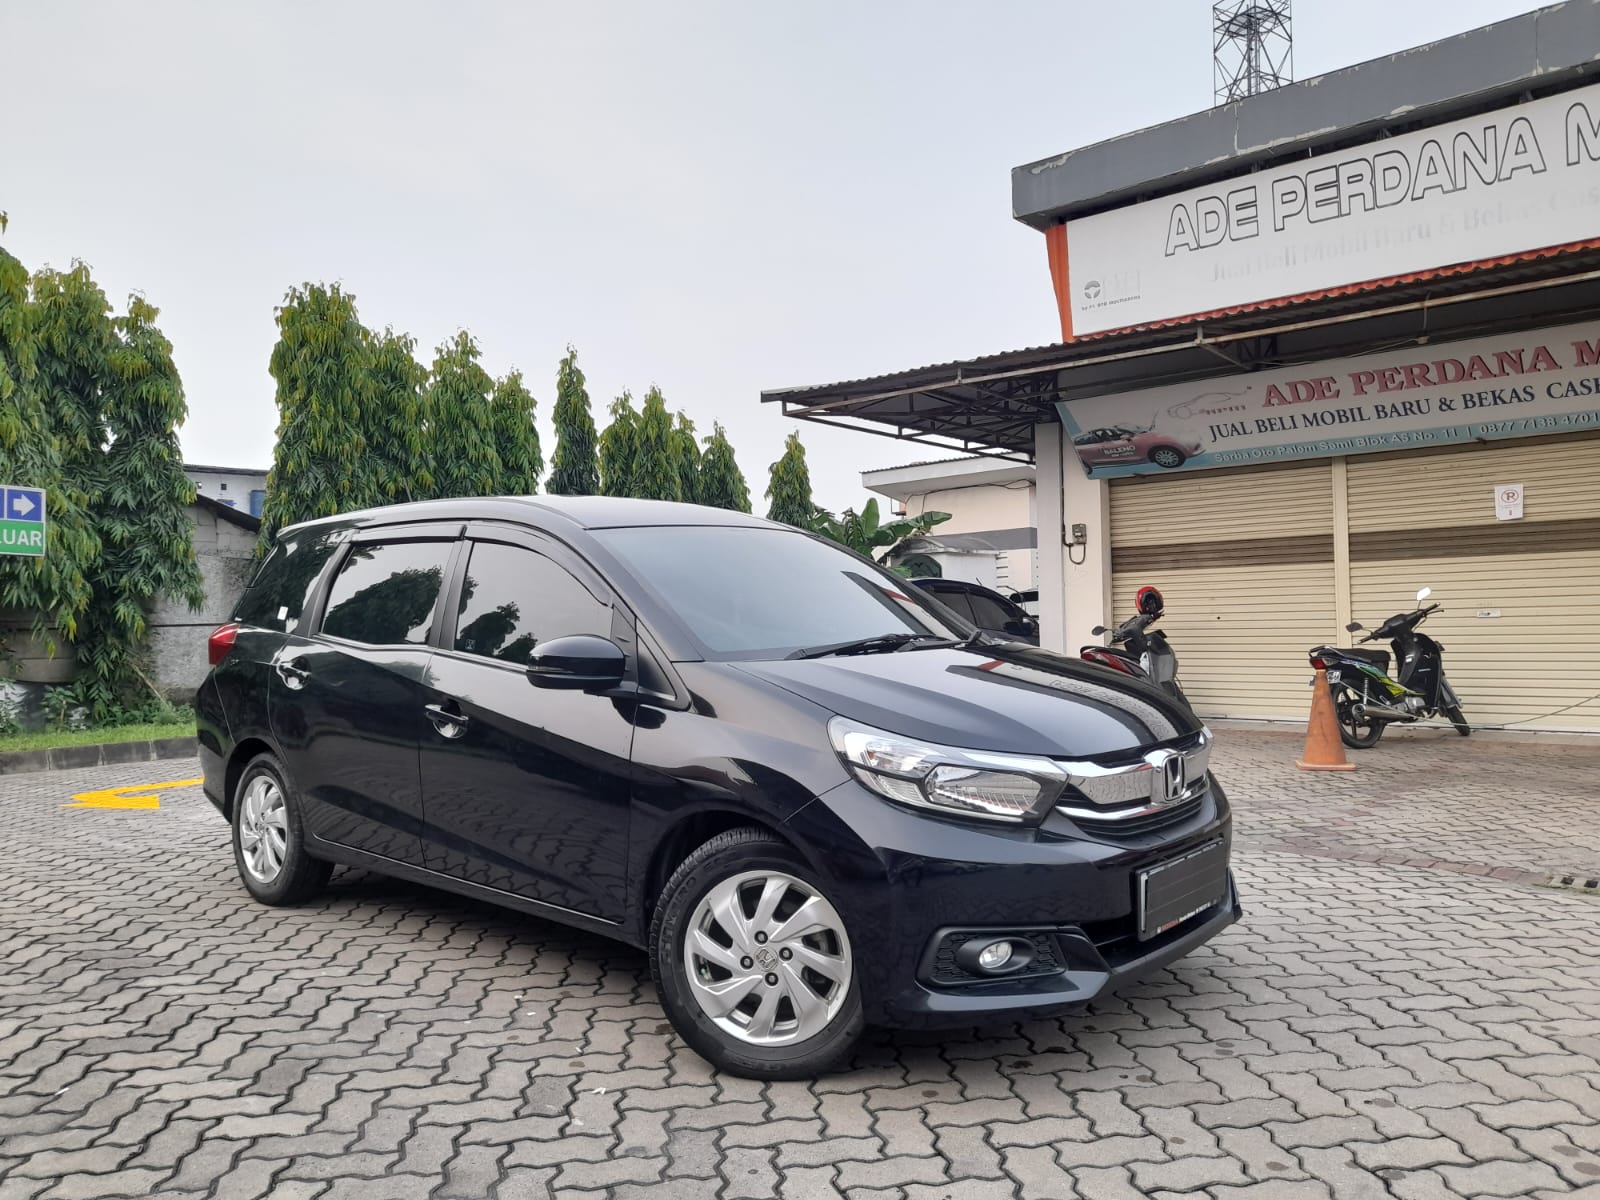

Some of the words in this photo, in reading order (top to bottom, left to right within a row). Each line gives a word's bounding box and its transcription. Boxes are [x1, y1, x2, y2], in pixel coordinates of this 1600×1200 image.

[1165, 185, 1259, 257] ADE
[1271, 116, 1547, 233] PERDANA
[1262, 376, 1340, 408] ADE
[1348, 345, 1562, 396] PERDANA
[1209, 422, 1253, 443] JUAL
[1255, 414, 1298, 434] BELI
[1301, 404, 1371, 428] MOBIL
[1374, 398, 1431, 420] BARU
[1438, 396, 1457, 412] &
[1461, 384, 1536, 410] BEKAS
[0, 528, 43, 547] UAR
